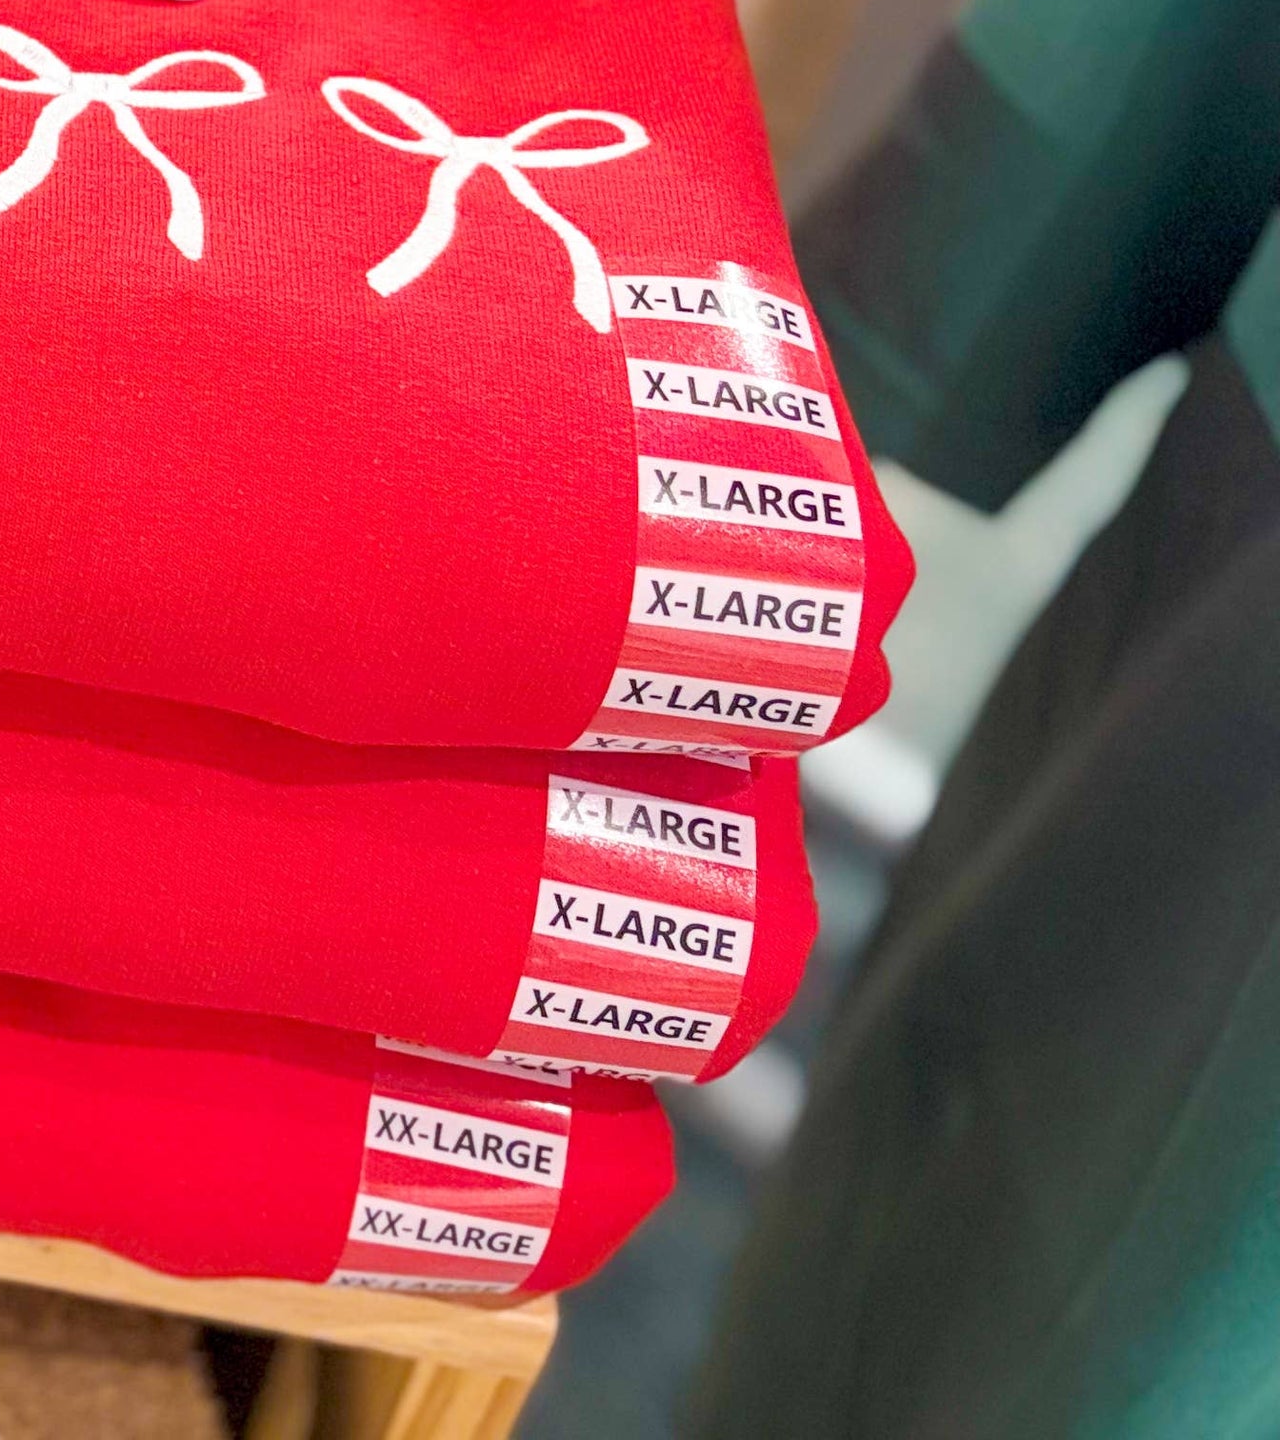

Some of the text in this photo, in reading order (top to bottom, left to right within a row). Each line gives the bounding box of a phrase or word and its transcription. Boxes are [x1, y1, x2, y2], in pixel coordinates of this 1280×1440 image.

[643, 370, 826, 428] X-LARGE
[654, 469, 846, 527] X-LARGE
[646, 580, 845, 637] X-LARGE
[620, 678, 821, 728] X-LARGE
[562, 788, 742, 857] X-LARGE
[549, 893, 737, 963] X-LARGE
[525, 989, 712, 1042] X-LARGE
[375, 1110, 554, 1175] XX-LARGE
[359, 1207, 535, 1257] XX-LARGE
